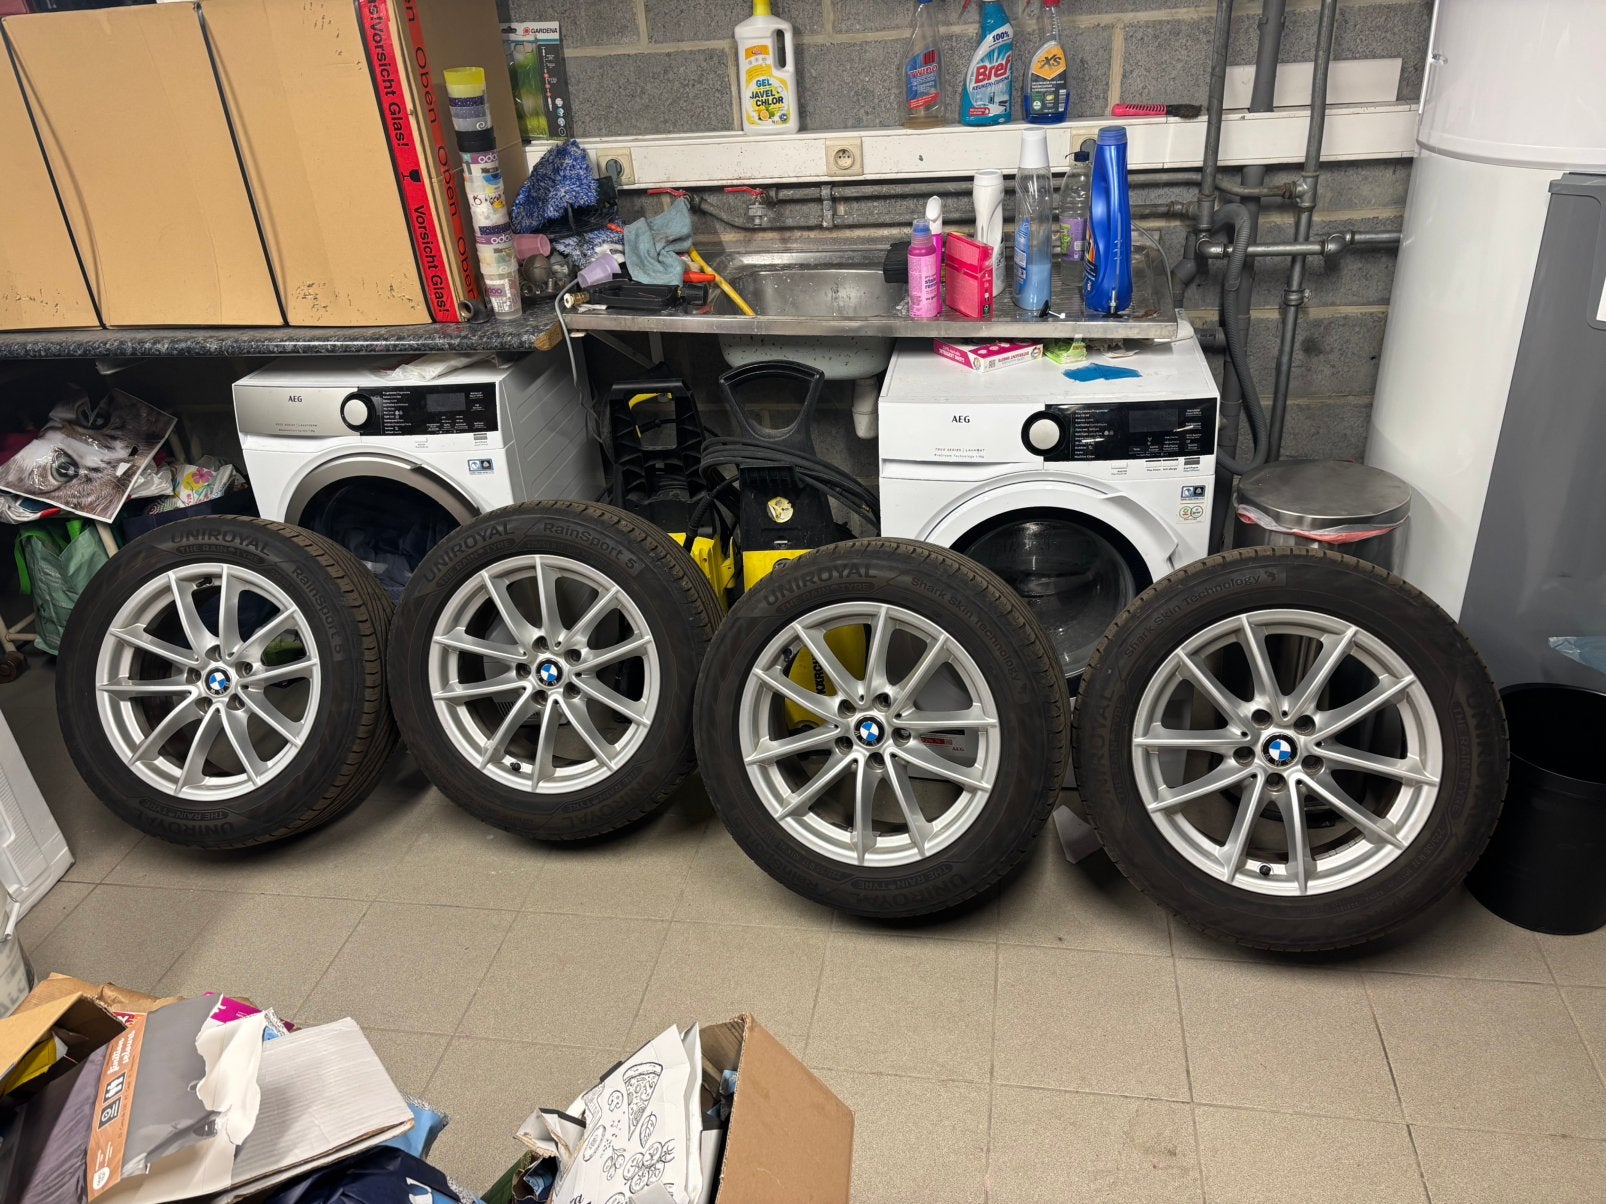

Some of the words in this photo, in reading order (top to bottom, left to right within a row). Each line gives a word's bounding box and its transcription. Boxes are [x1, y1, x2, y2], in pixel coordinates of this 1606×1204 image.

[991, 31, 1010, 43] 100%
[371, 22, 397, 97] Vorsicht
[388, 102, 409, 147] Glas!
[415, 46, 438, 124] Oben
[755, 78, 773, 87] GEL
[974, 54, 1012, 85] Bref
[749, 89, 776, 99] JAVEL
[755, 97, 784, 107] CHLOR
[437, 146, 458, 217] Oben
[413, 205, 439, 271] Vorsicht
[431, 274, 450, 313] Glas!
[287, 395, 303, 403] AEG
[951, 415, 971, 424] AEG
[170, 528, 271, 556] UNIROYAL
[424, 520, 516, 584] UNIROYAL
[543, 522, 623, 561] RainSport
[624, 557, 635, 570] 5
[763, 562, 878, 606] UNIROYAL
[291, 564, 341, 639] RainSport
[334, 644, 344, 654] 5
[910, 575, 948, 600] Shark
[948, 595, 975, 619] Skin
[973, 617, 1021, 681] Technology
[1125, 626, 1156, 659] Shark
[1154, 603, 1183, 626] Skin
[1182, 574, 1262, 606] Technology
[1459, 736, 1471, 770] RAIN
[1451, 779, 1471, 815] TYRE
